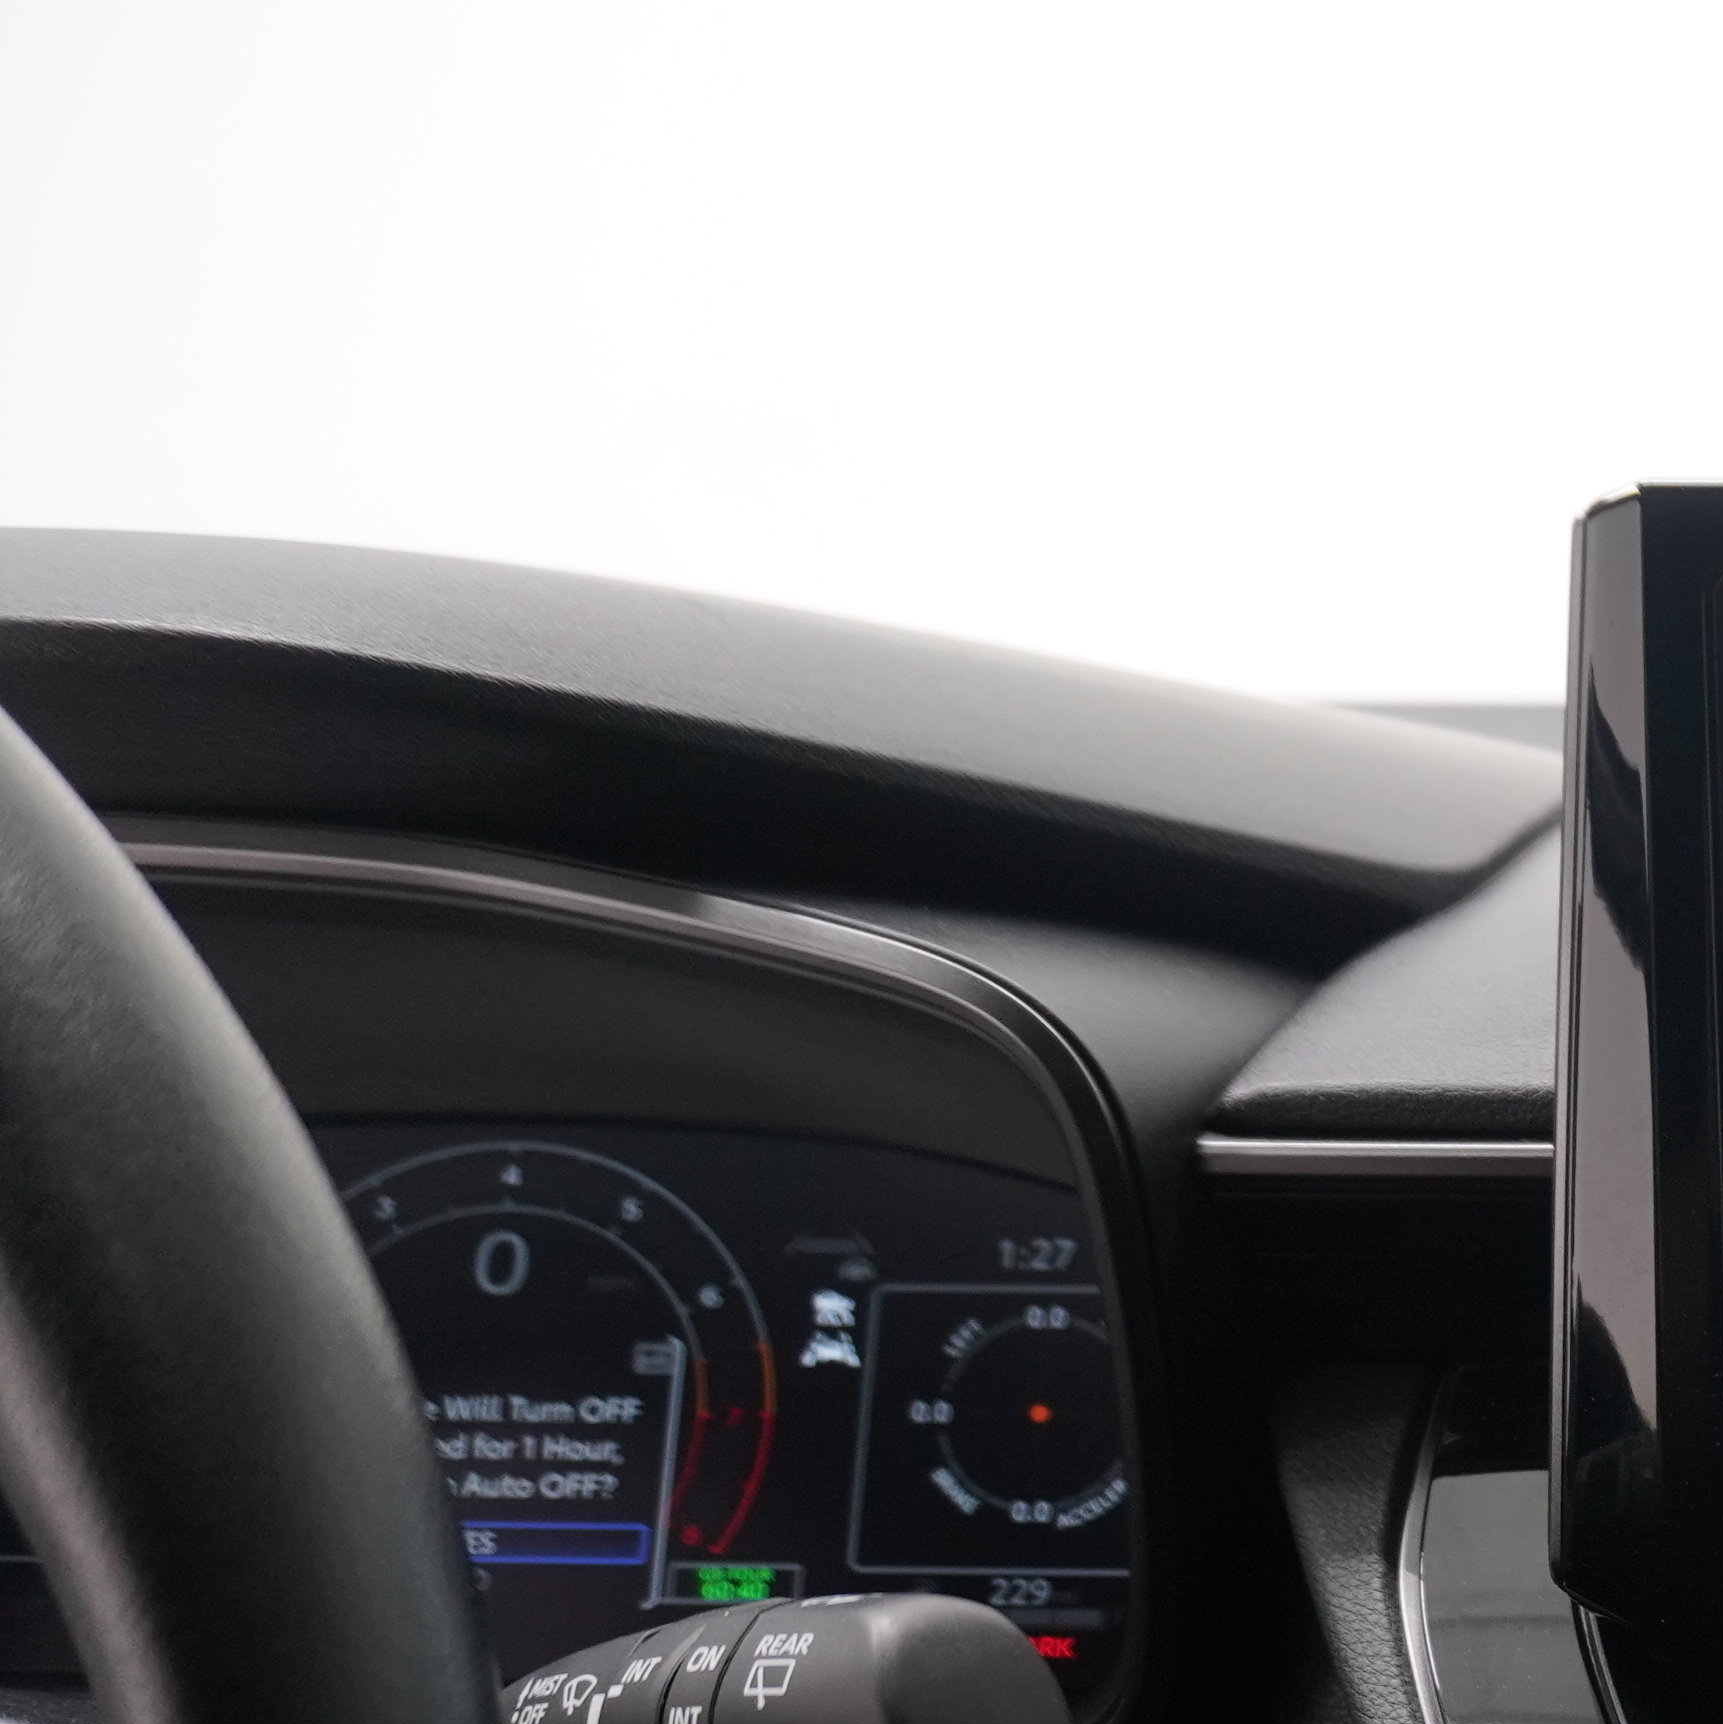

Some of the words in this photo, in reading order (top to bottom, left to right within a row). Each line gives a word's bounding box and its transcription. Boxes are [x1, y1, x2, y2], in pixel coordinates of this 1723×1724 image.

[500, 1163, 523, 1187] 4
[473, 1229, 530, 1297] 0
[999, 1236, 1078, 1271] 1:27
[1023, 1304, 1072, 1330] 0.0
[444, 1394, 504, 1423] Will
[507, 1394, 576, 1423] Turn
[577, 1395, 645, 1424] OFF
[908, 1399, 954, 1425] 0.0
[472, 1431, 518, 1461] for
[461, 1471, 537, 1499] Auto
[538, 1471, 620, 1500] OFF?
[1009, 1499, 1055, 1524] 0.0
[990, 1577, 1054, 1607] 229
[686, 1645, 726, 1672] ON
[754, 1633, 814, 1657] REAR
[621, 1656, 662, 1684] INT
[528, 1673, 568, 1699] MIST
